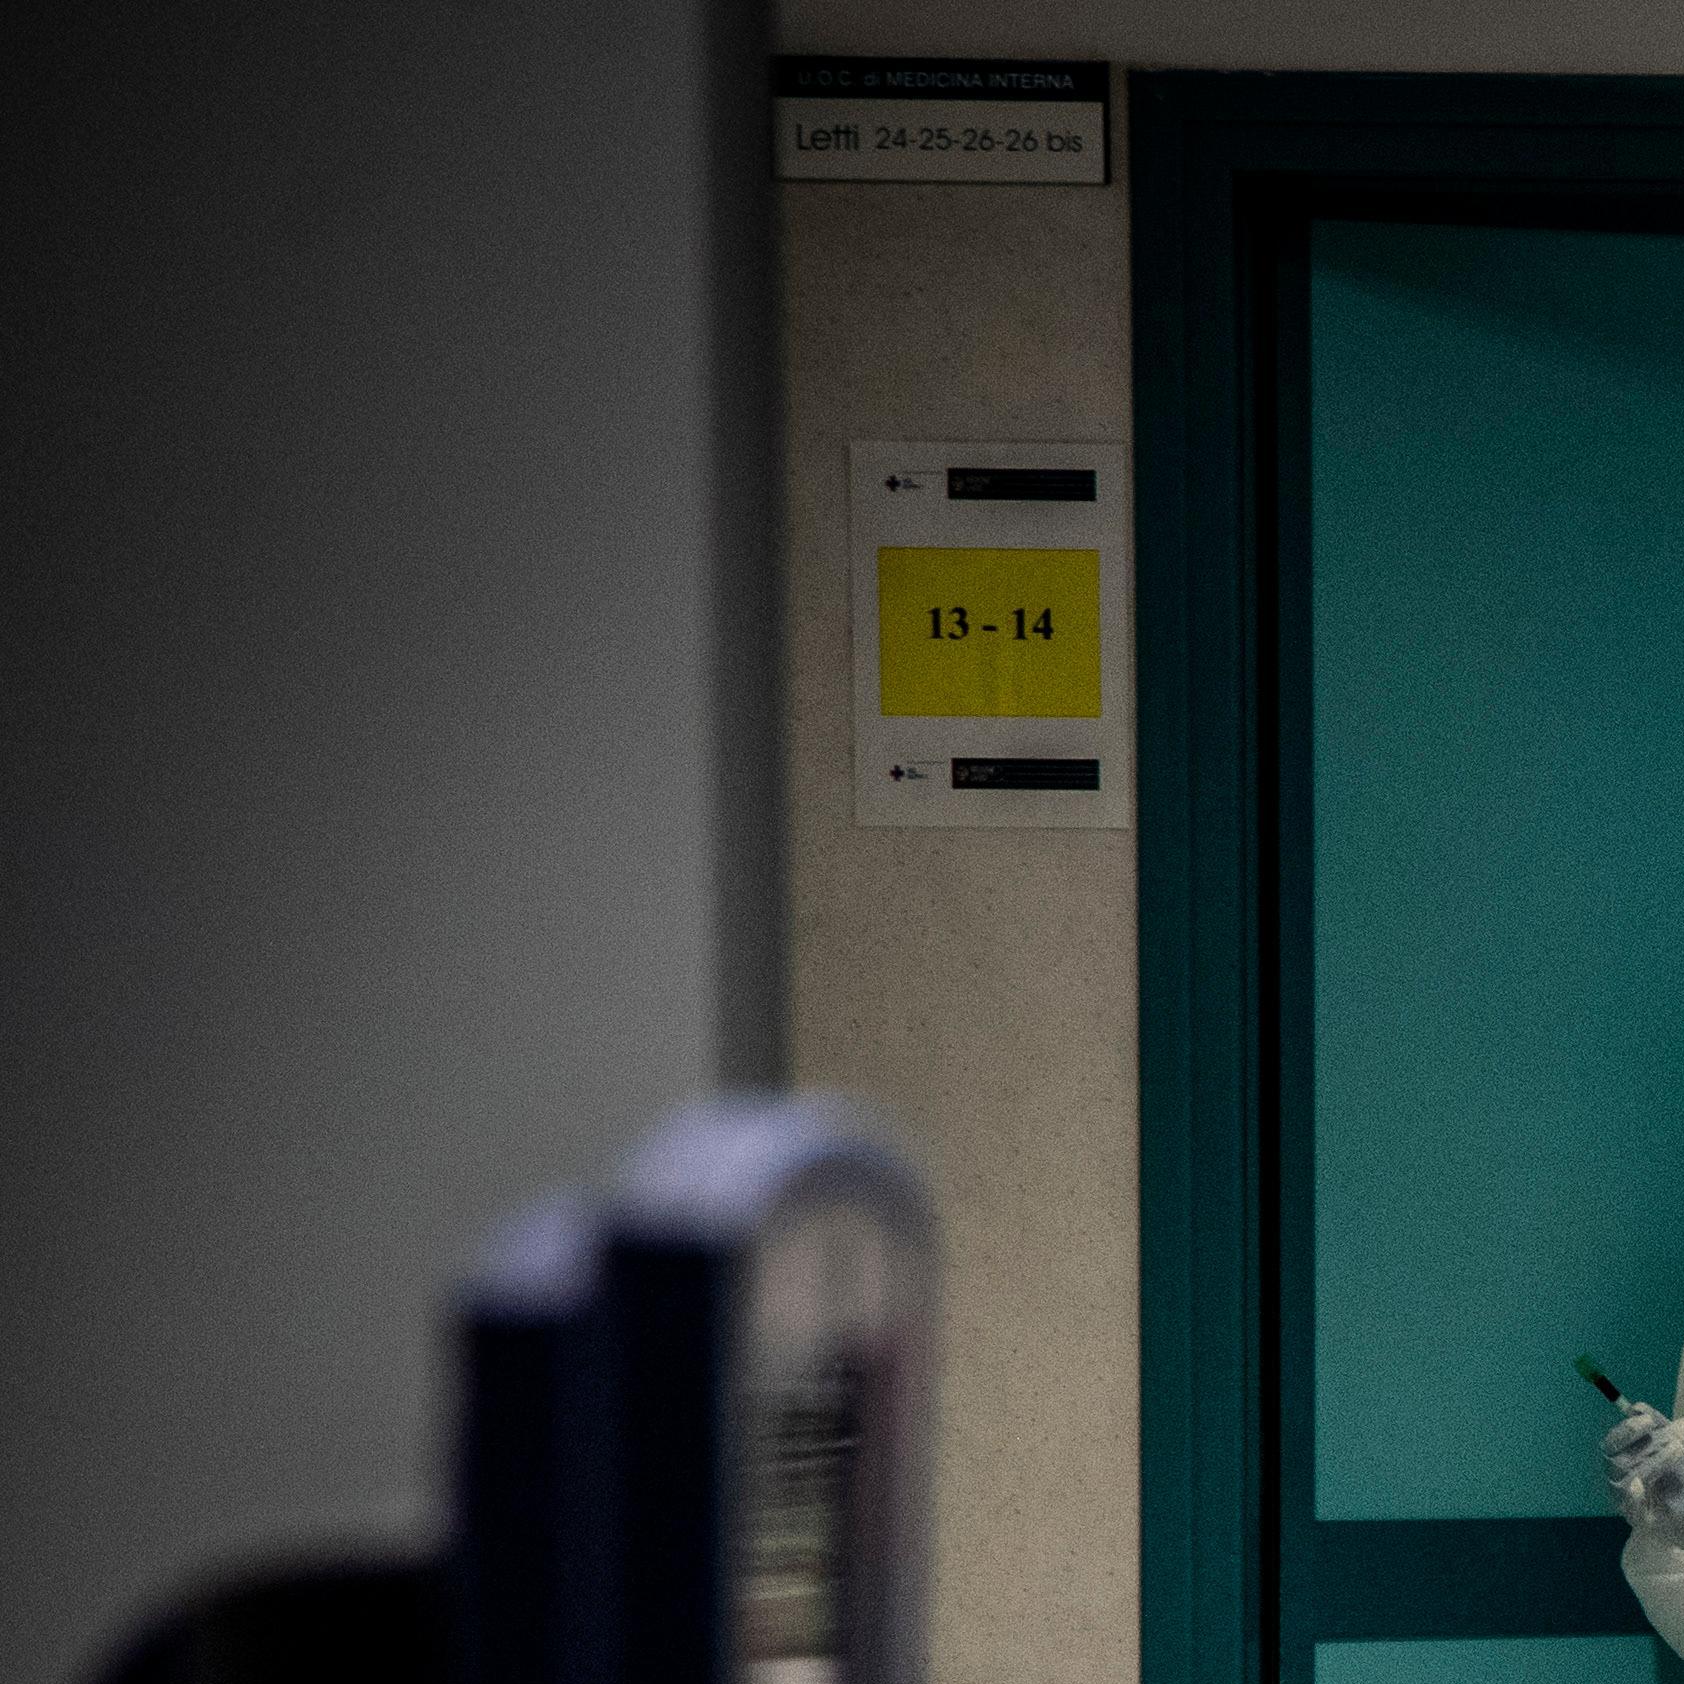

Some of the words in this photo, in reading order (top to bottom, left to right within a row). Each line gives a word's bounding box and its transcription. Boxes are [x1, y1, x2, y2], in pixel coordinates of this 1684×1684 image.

[863, 70, 881, 87] di
[885, 70, 983, 89] MEDICINA
[988, 71, 1075, 90] INTERNA
[796, 124, 860, 151] Letti
[875, 127, 1039, 153] 24-25-26-26
[1045, 129, 1084, 153] bis
[927, 607, 969, 640] 13
[1011, 607, 1055, 640] 14
